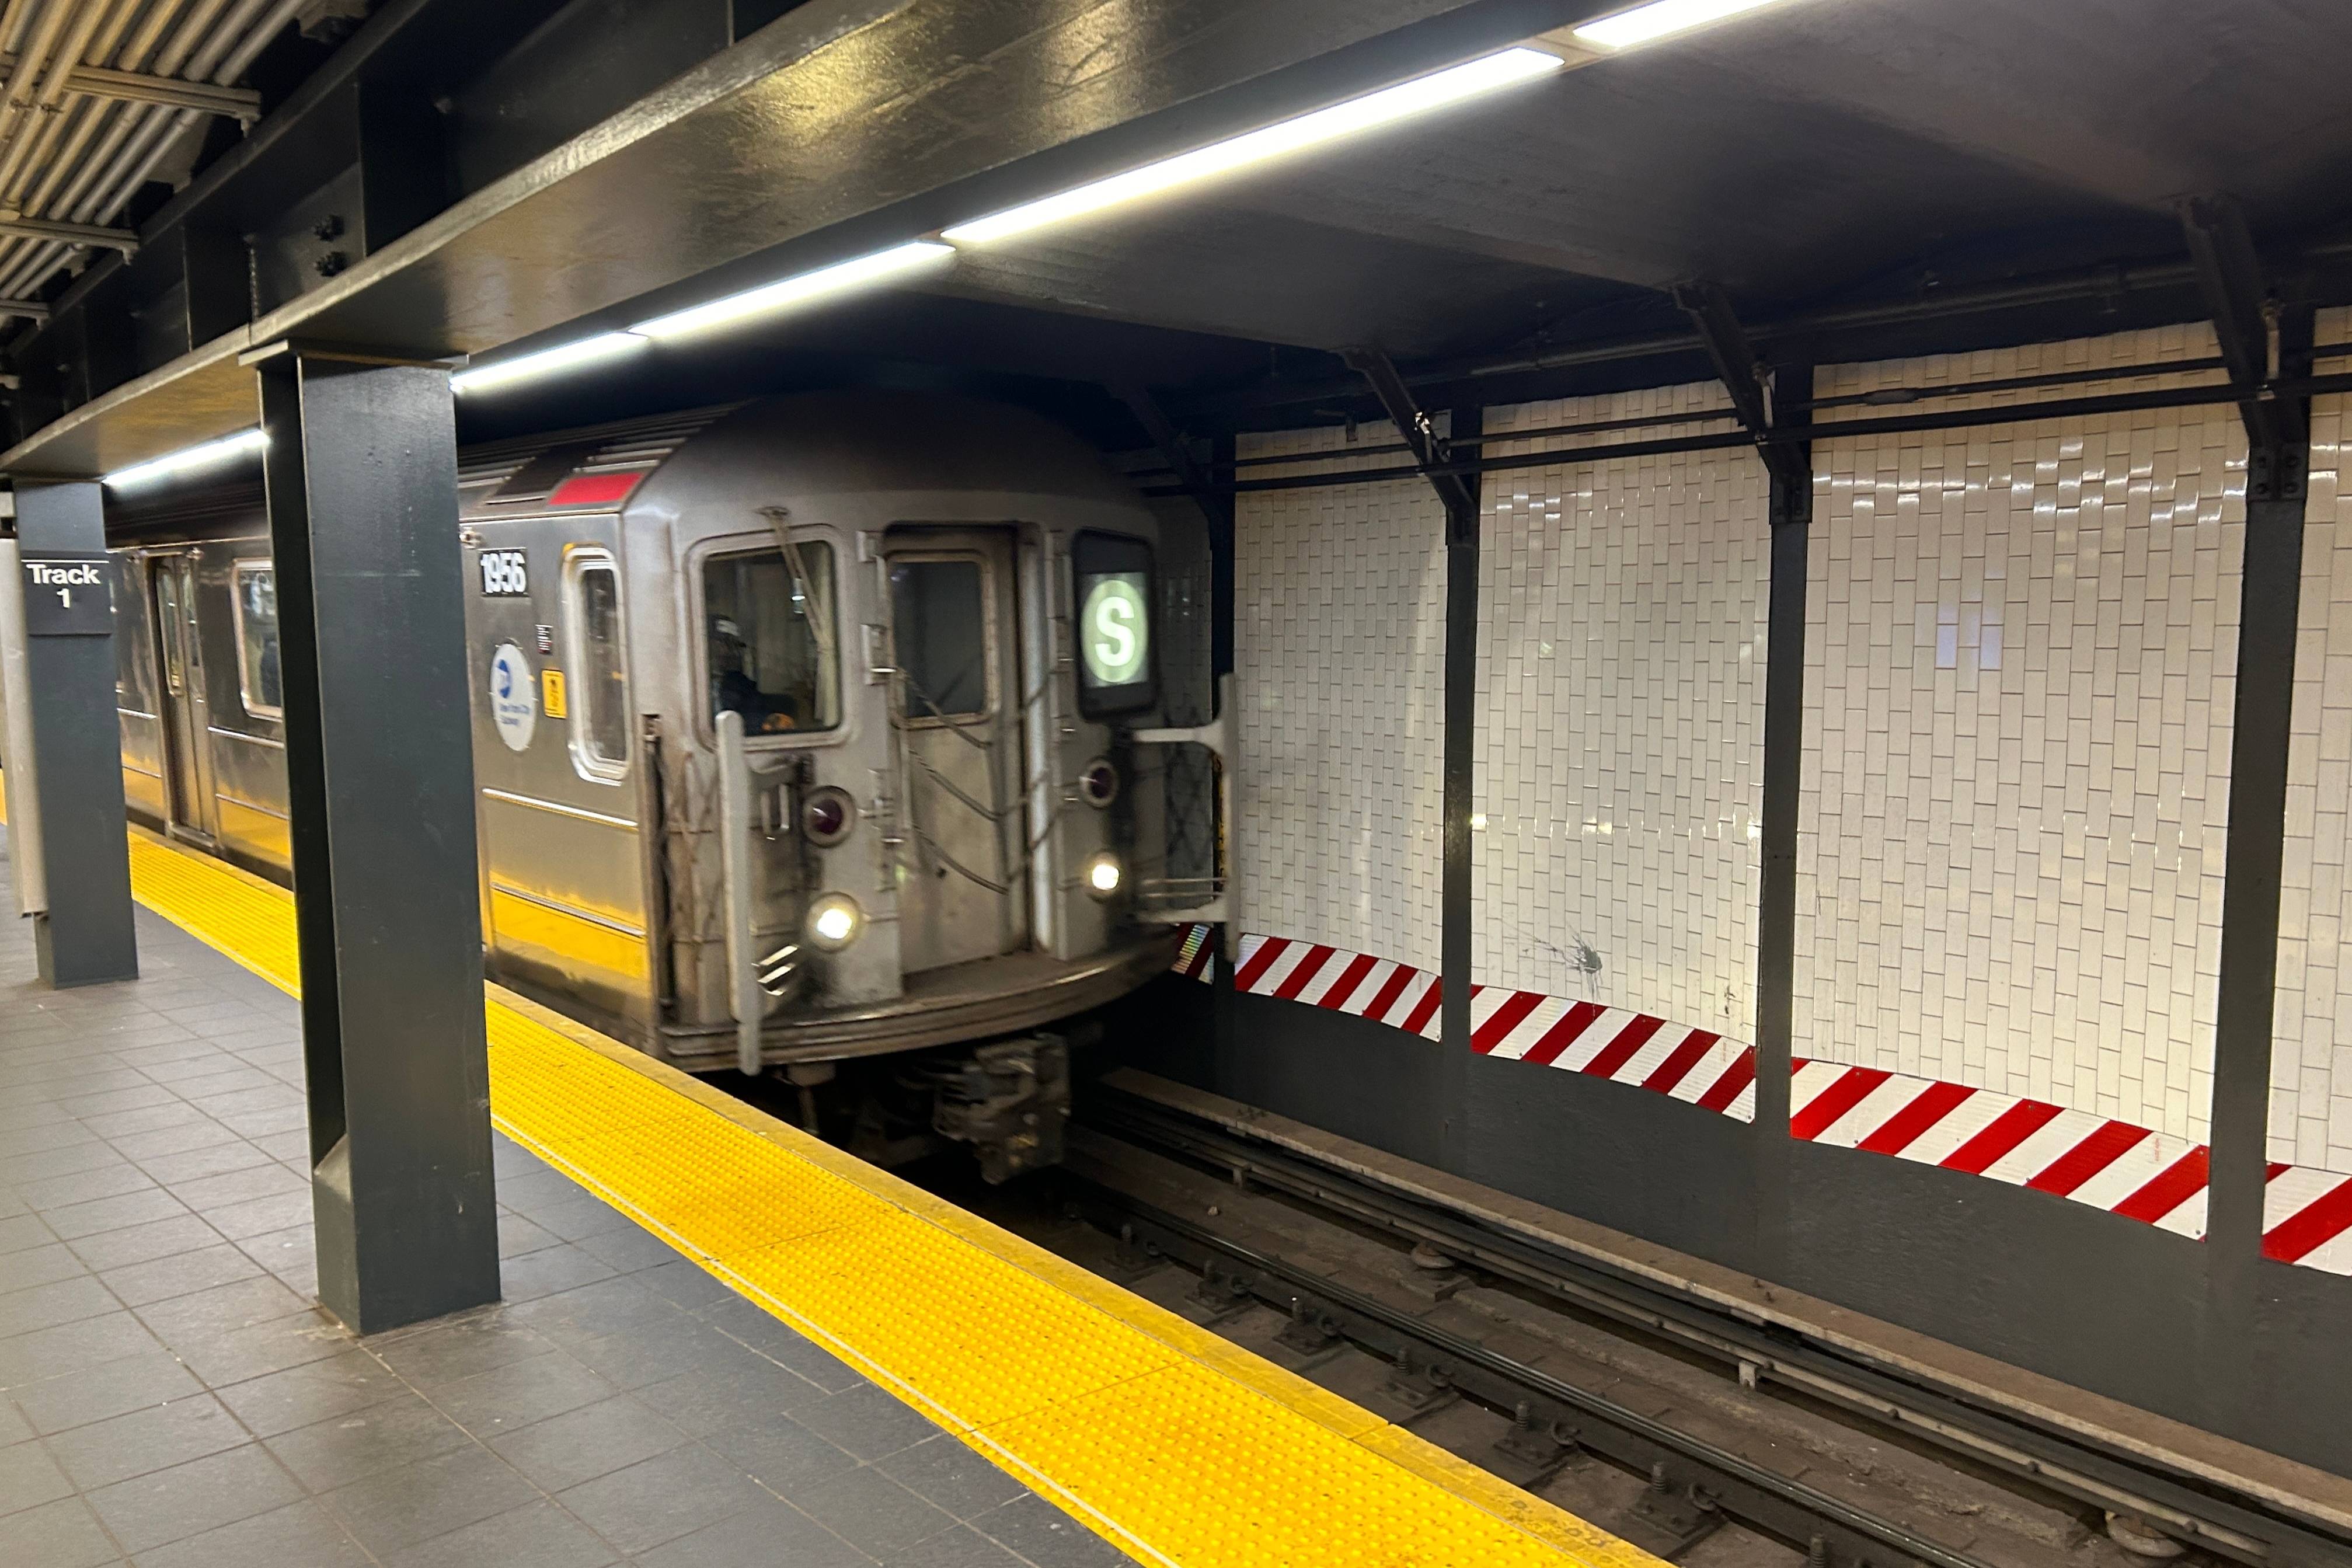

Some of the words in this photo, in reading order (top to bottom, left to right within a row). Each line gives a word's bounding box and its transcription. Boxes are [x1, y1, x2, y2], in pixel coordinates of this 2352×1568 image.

[26, 564, 100, 584] Track
[480, 552, 526, 593] 1956
[57, 588, 70, 608] 1
[1095, 596, 1135, 666] S
